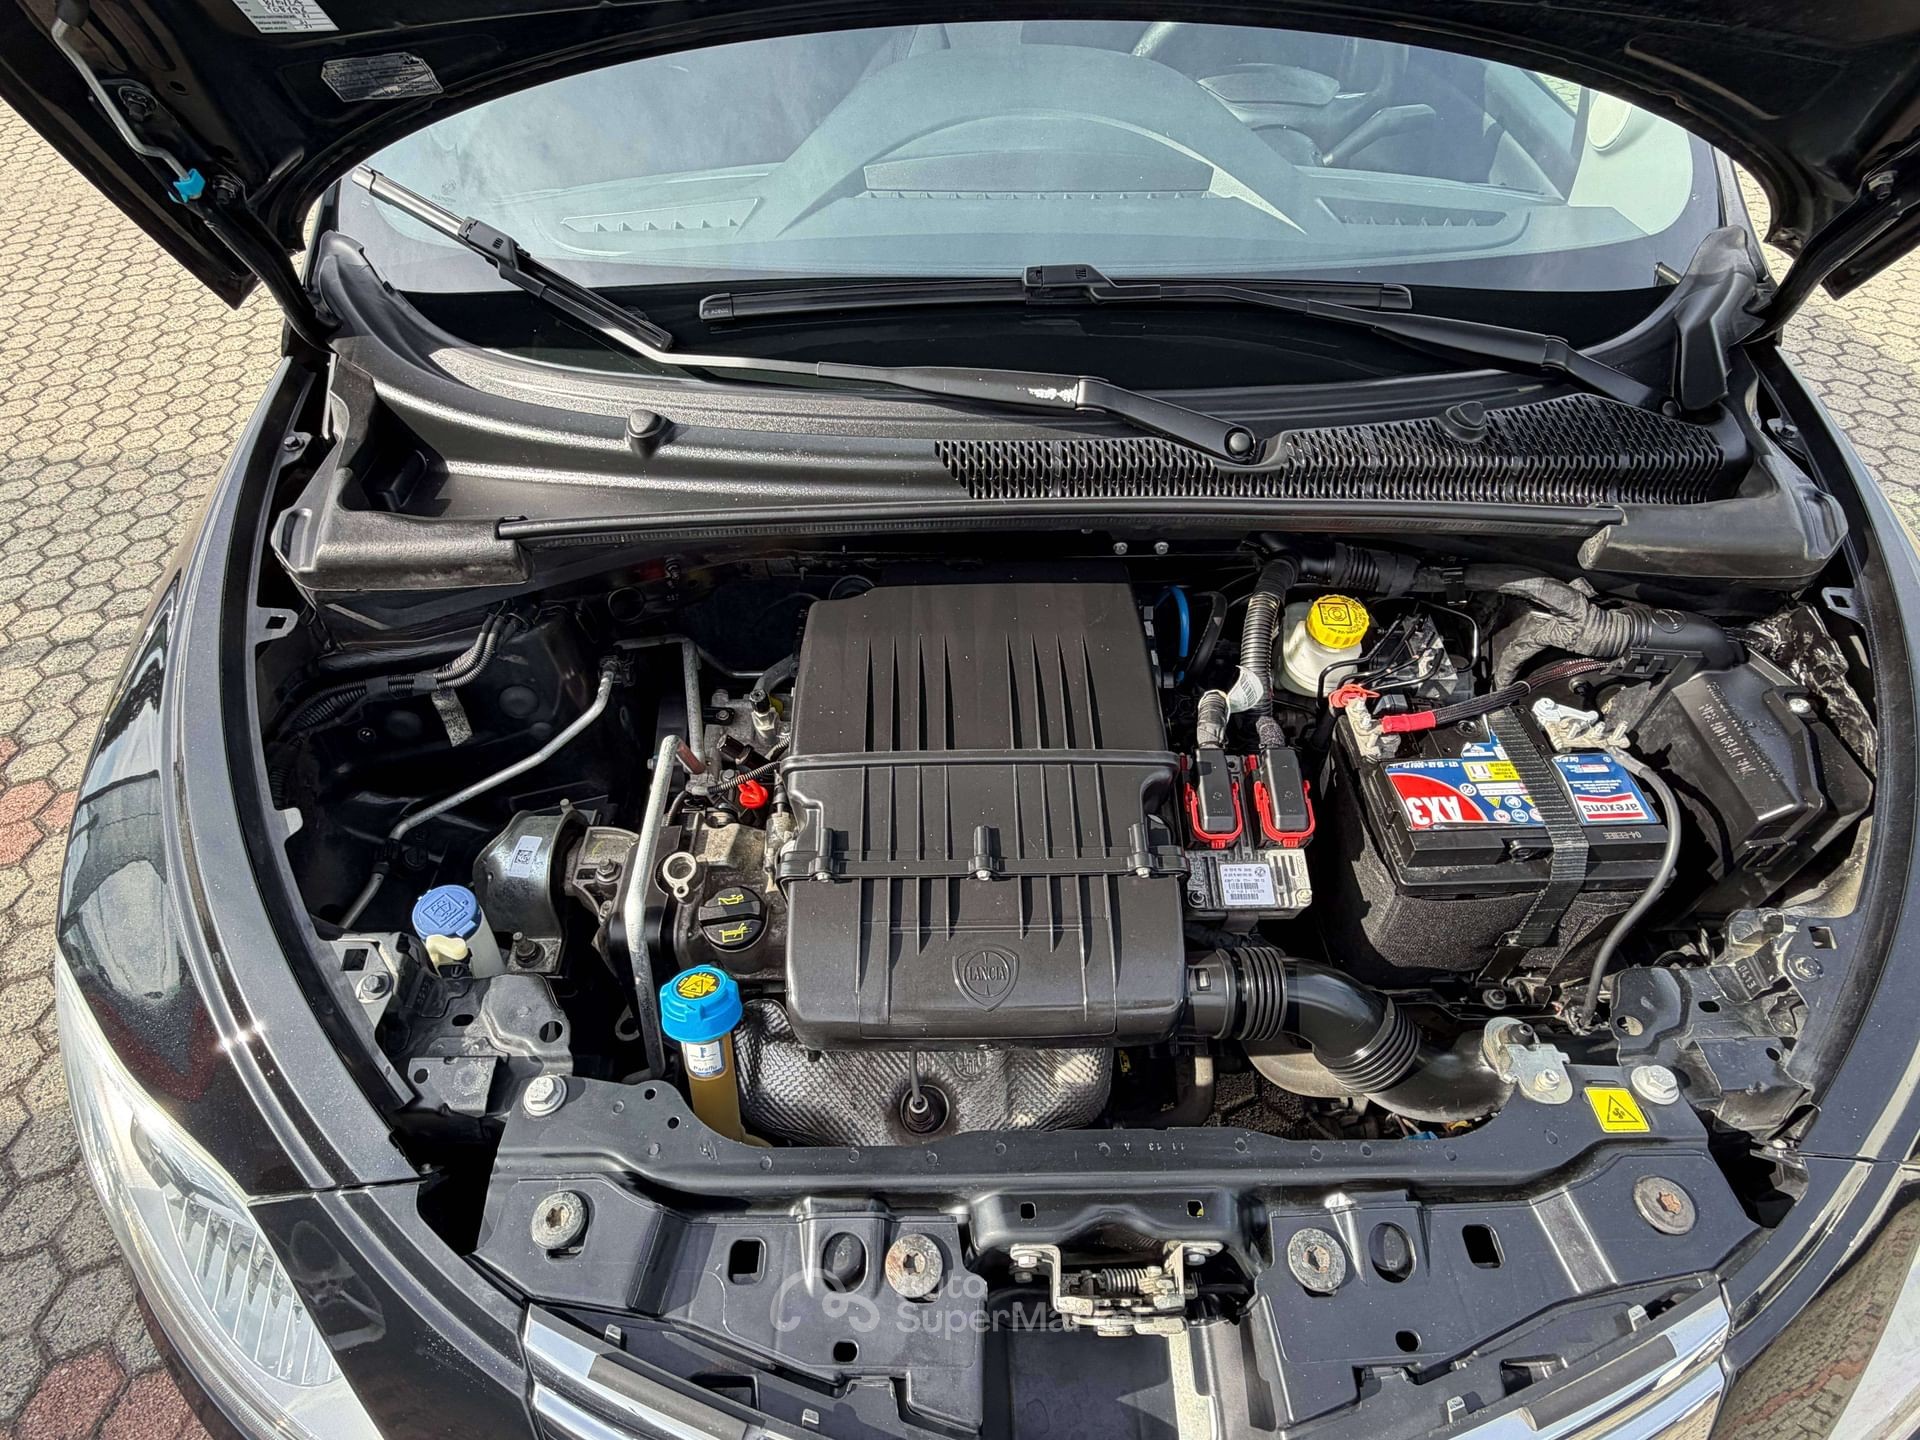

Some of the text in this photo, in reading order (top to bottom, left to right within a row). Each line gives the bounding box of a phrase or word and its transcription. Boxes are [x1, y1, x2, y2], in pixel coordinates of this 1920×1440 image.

[1408, 796, 1462, 826] AX3
[1582, 802, 1640, 814] arexons
[967, 966, 1007, 981] LANCIA
